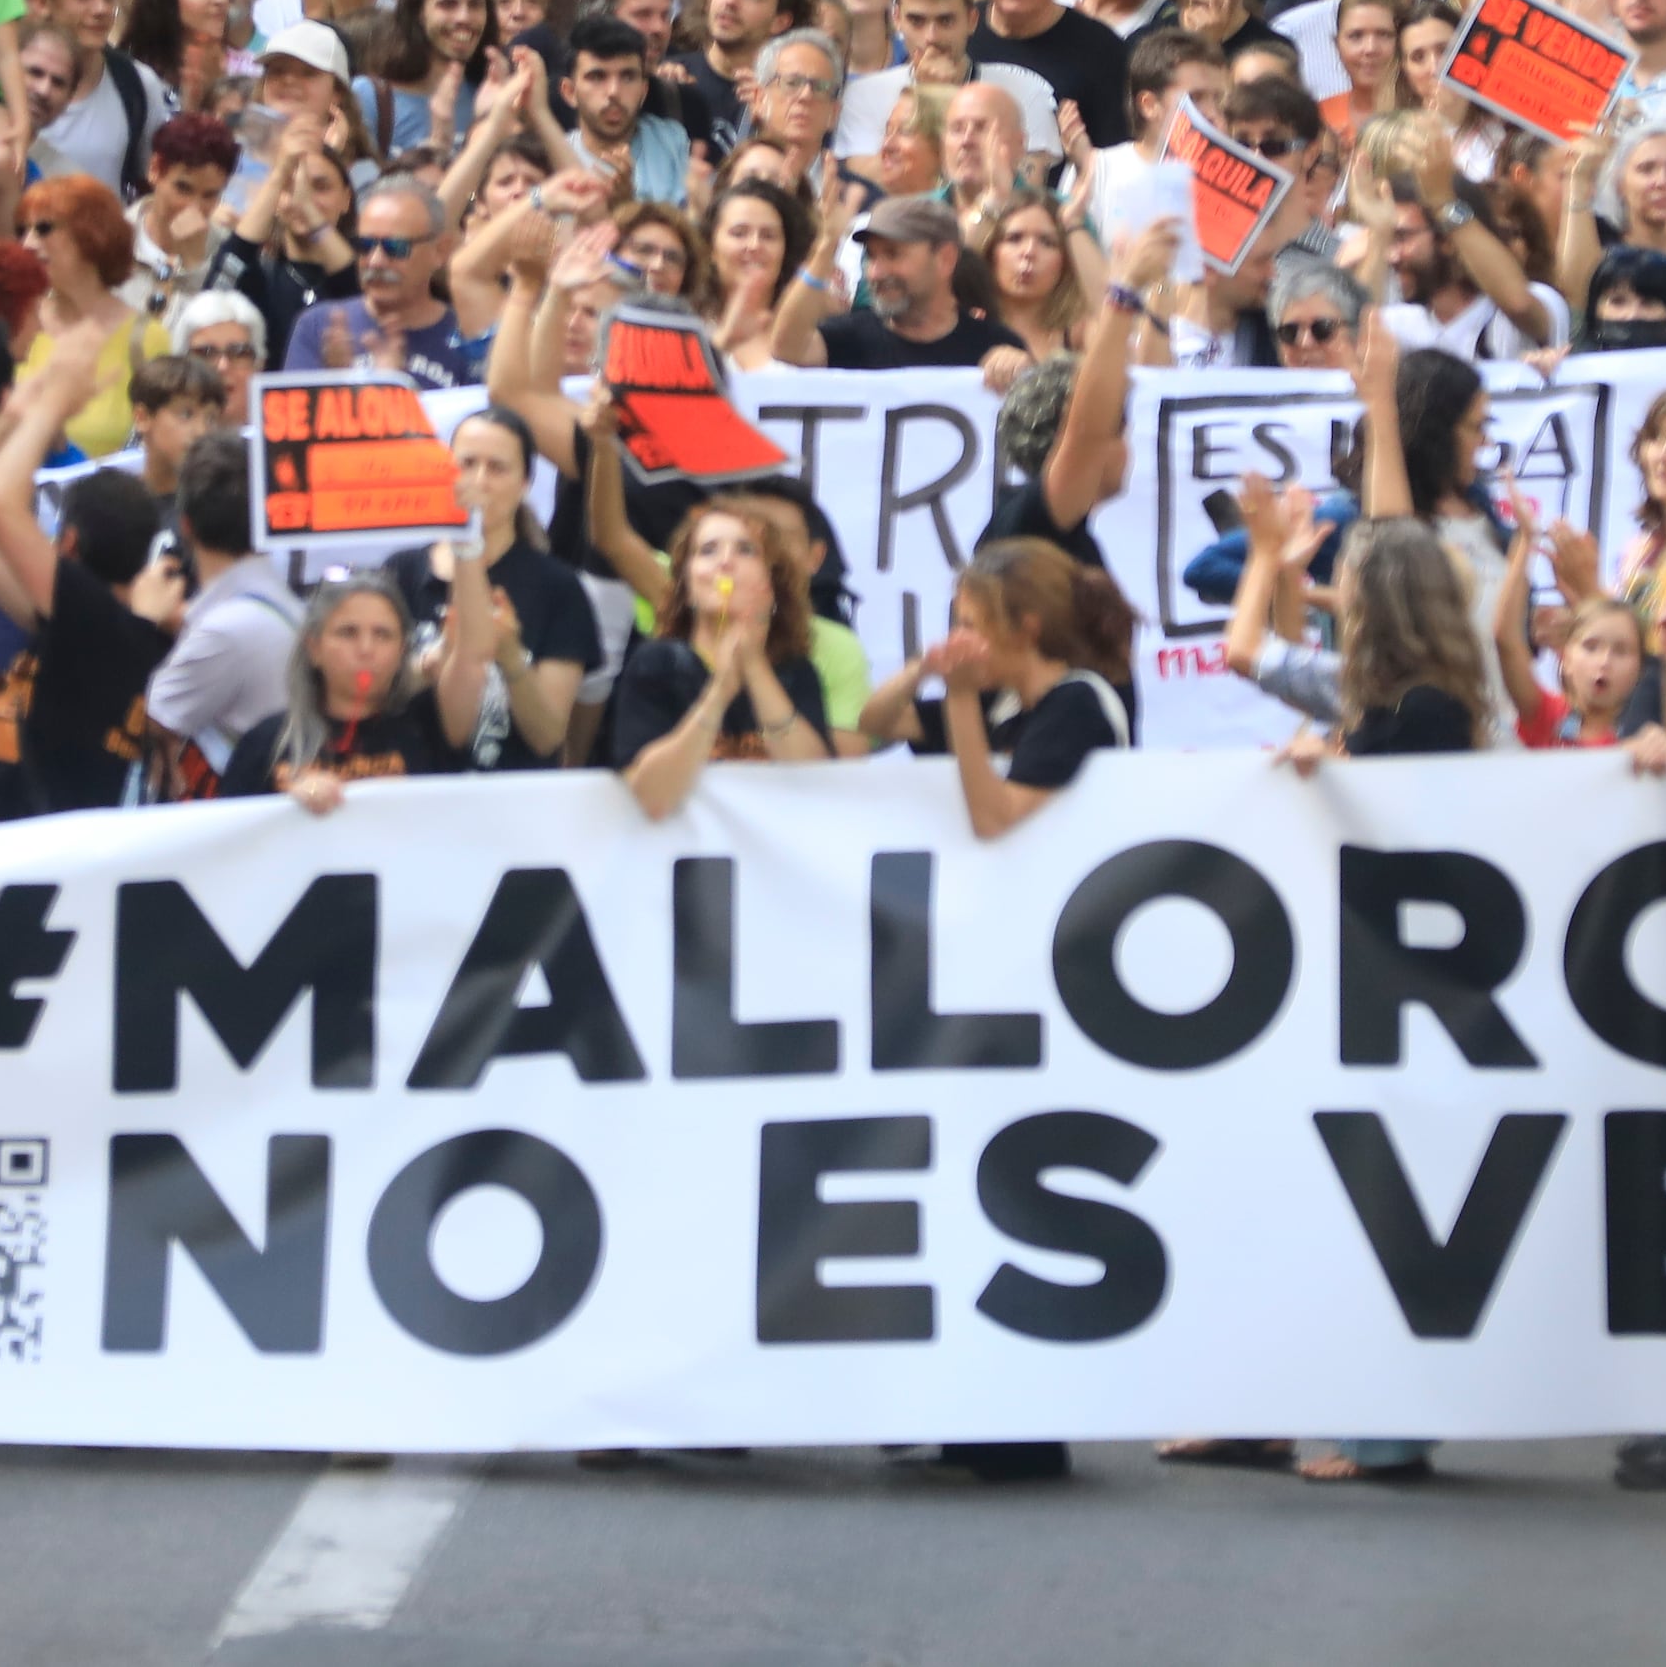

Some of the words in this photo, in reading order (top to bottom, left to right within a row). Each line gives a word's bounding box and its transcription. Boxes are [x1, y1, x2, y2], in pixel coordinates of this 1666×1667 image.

[1522, 7, 1629, 92] VENDE
[263, 388, 311, 443] SE
[100, 1127, 607, 1357] NO
[757, 1110, 1169, 1344] ES
